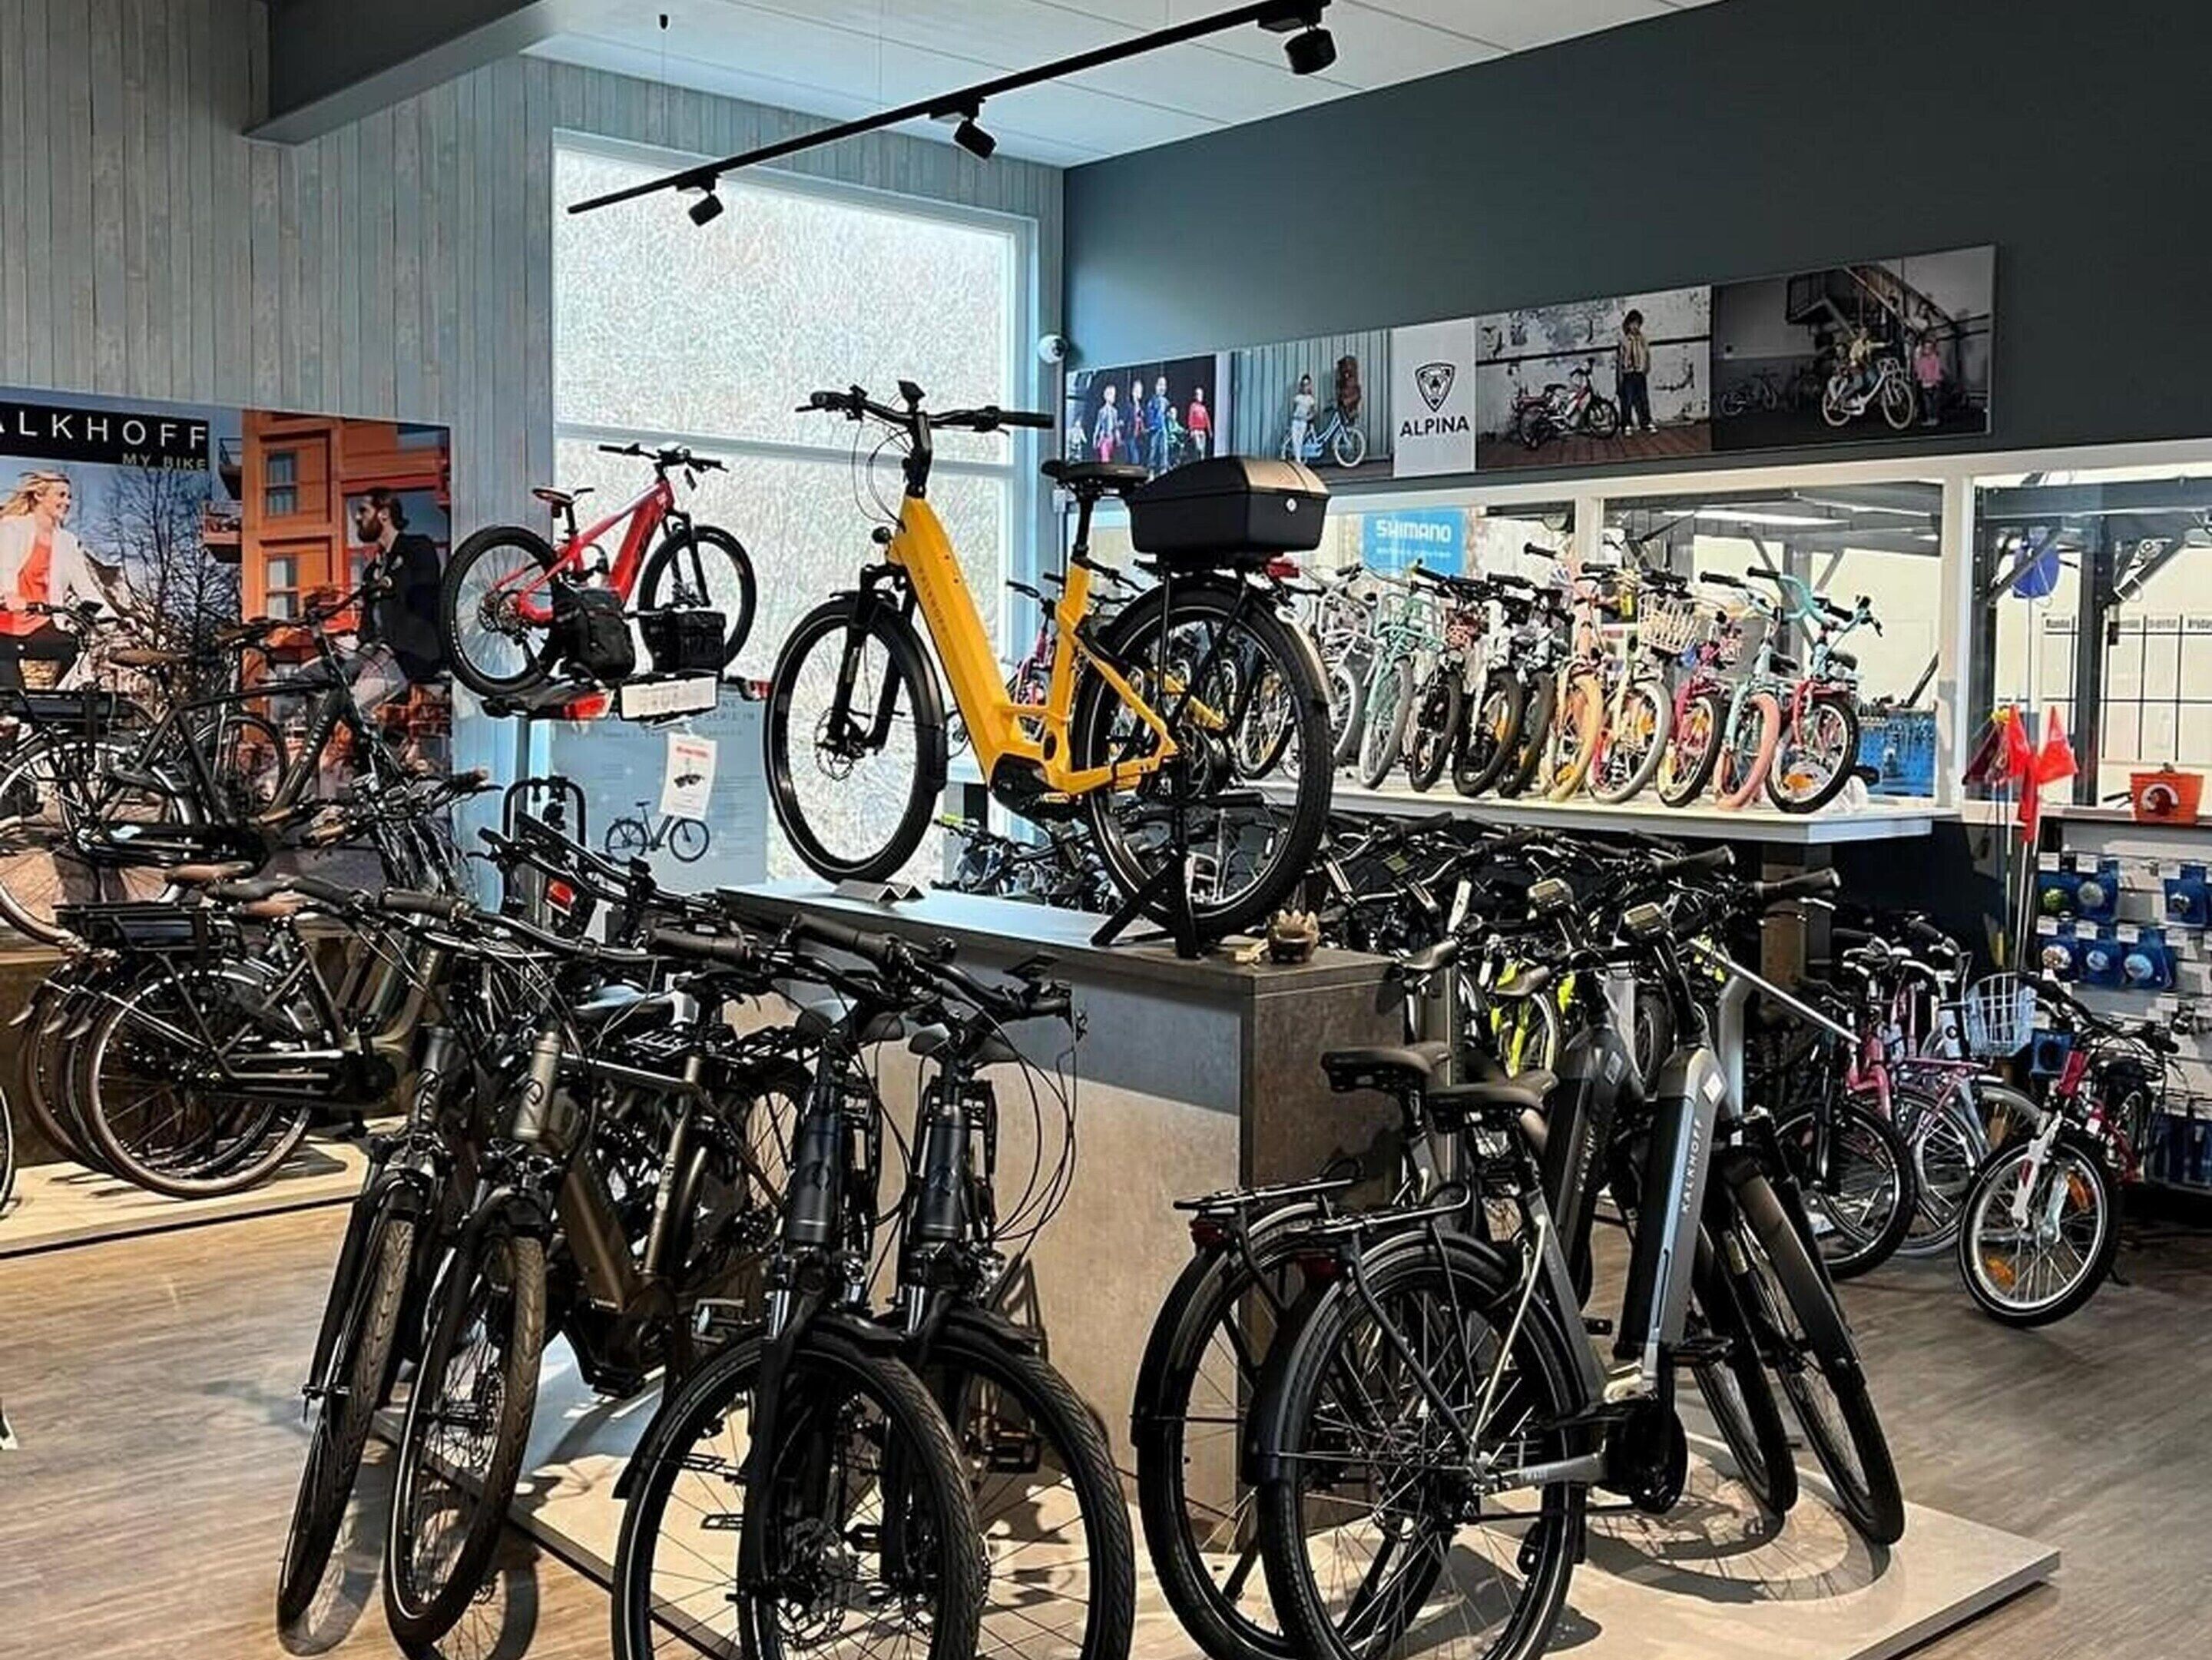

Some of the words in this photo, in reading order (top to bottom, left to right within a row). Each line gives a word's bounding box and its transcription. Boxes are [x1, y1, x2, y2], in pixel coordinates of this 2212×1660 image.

[0, 410, 207, 449] LKHOFF
[1399, 416, 1469, 436] ALPINA
[122, 452, 151, 466] MY
[163, 456, 206, 471] BIKE
[1376, 519, 1452, 543] SHIMANO
[1681, 1118, 1702, 1212] KALKHOFF
